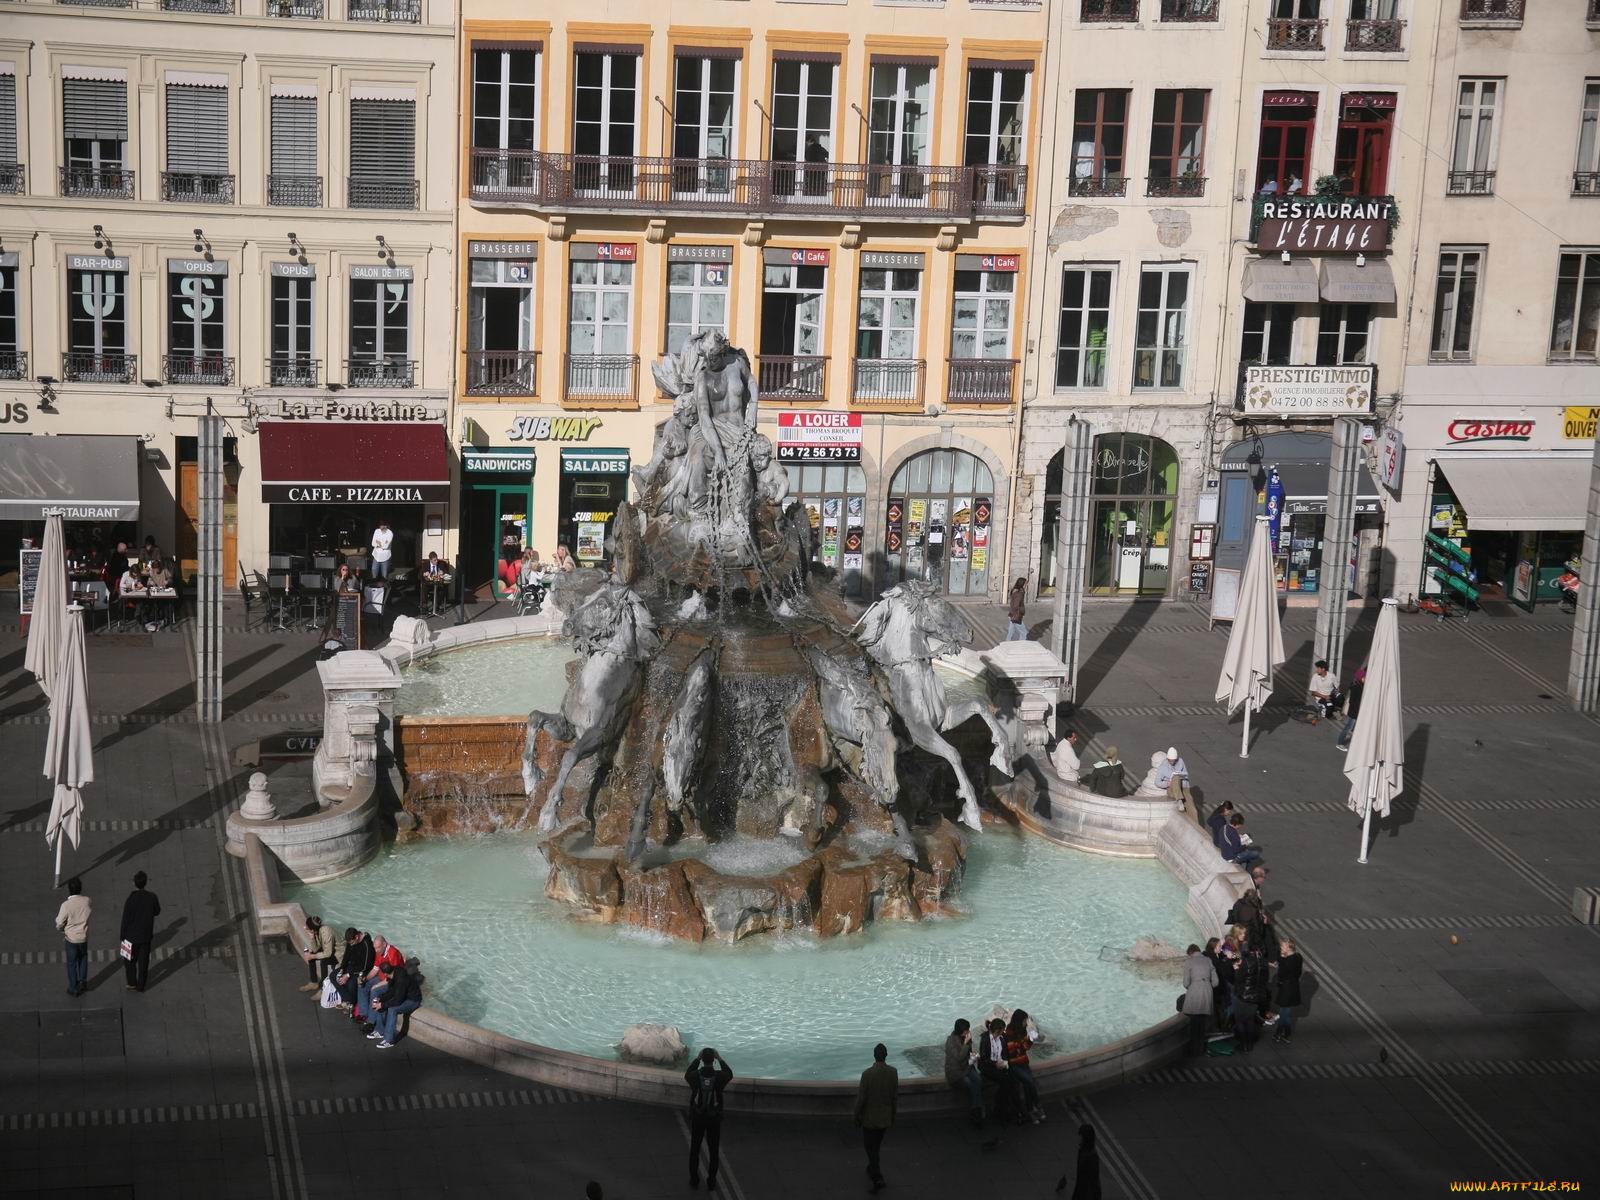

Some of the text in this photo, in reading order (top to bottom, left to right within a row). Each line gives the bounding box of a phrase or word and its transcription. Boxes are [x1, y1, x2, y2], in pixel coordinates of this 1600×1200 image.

[1263, 203, 1391, 219] RESTAURANT
[474, 244, 531, 253] BRASSERIE
[613, 246, 632, 256] Café
[672, 248, 727, 258] BRASSERIE
[807, 252, 825, 261] Café
[865, 254, 919, 264] BRASSERIE
[73, 258, 122, 269] BAR-PUB
[997, 258, 1015, 267] Café
[354, 268, 378, 277] SALON
[381, 268, 392, 277] DE
[1249, 369, 1370, 384] PRESTIG'IMMO
[1271, 397, 1345, 407] 04 72 00 88 88
[278, 400, 427, 418] La Fontaine
[793, 414, 849, 427] A LOUER
[506, 416, 602, 440] SUBWAY
[1447, 419, 1533, 440] Casino
[781, 447, 857, 457] 04 72 56 73 73
[467, 459, 532, 470] SANDWICHS
[565, 461, 626, 472] SALADES
[288, 488, 331, 501] CAFE
[347, 489, 423, 502] PIZZERIA
[42, 507, 120, 518] RSTAURANT
[572, 512, 614, 522] SUBWAY
